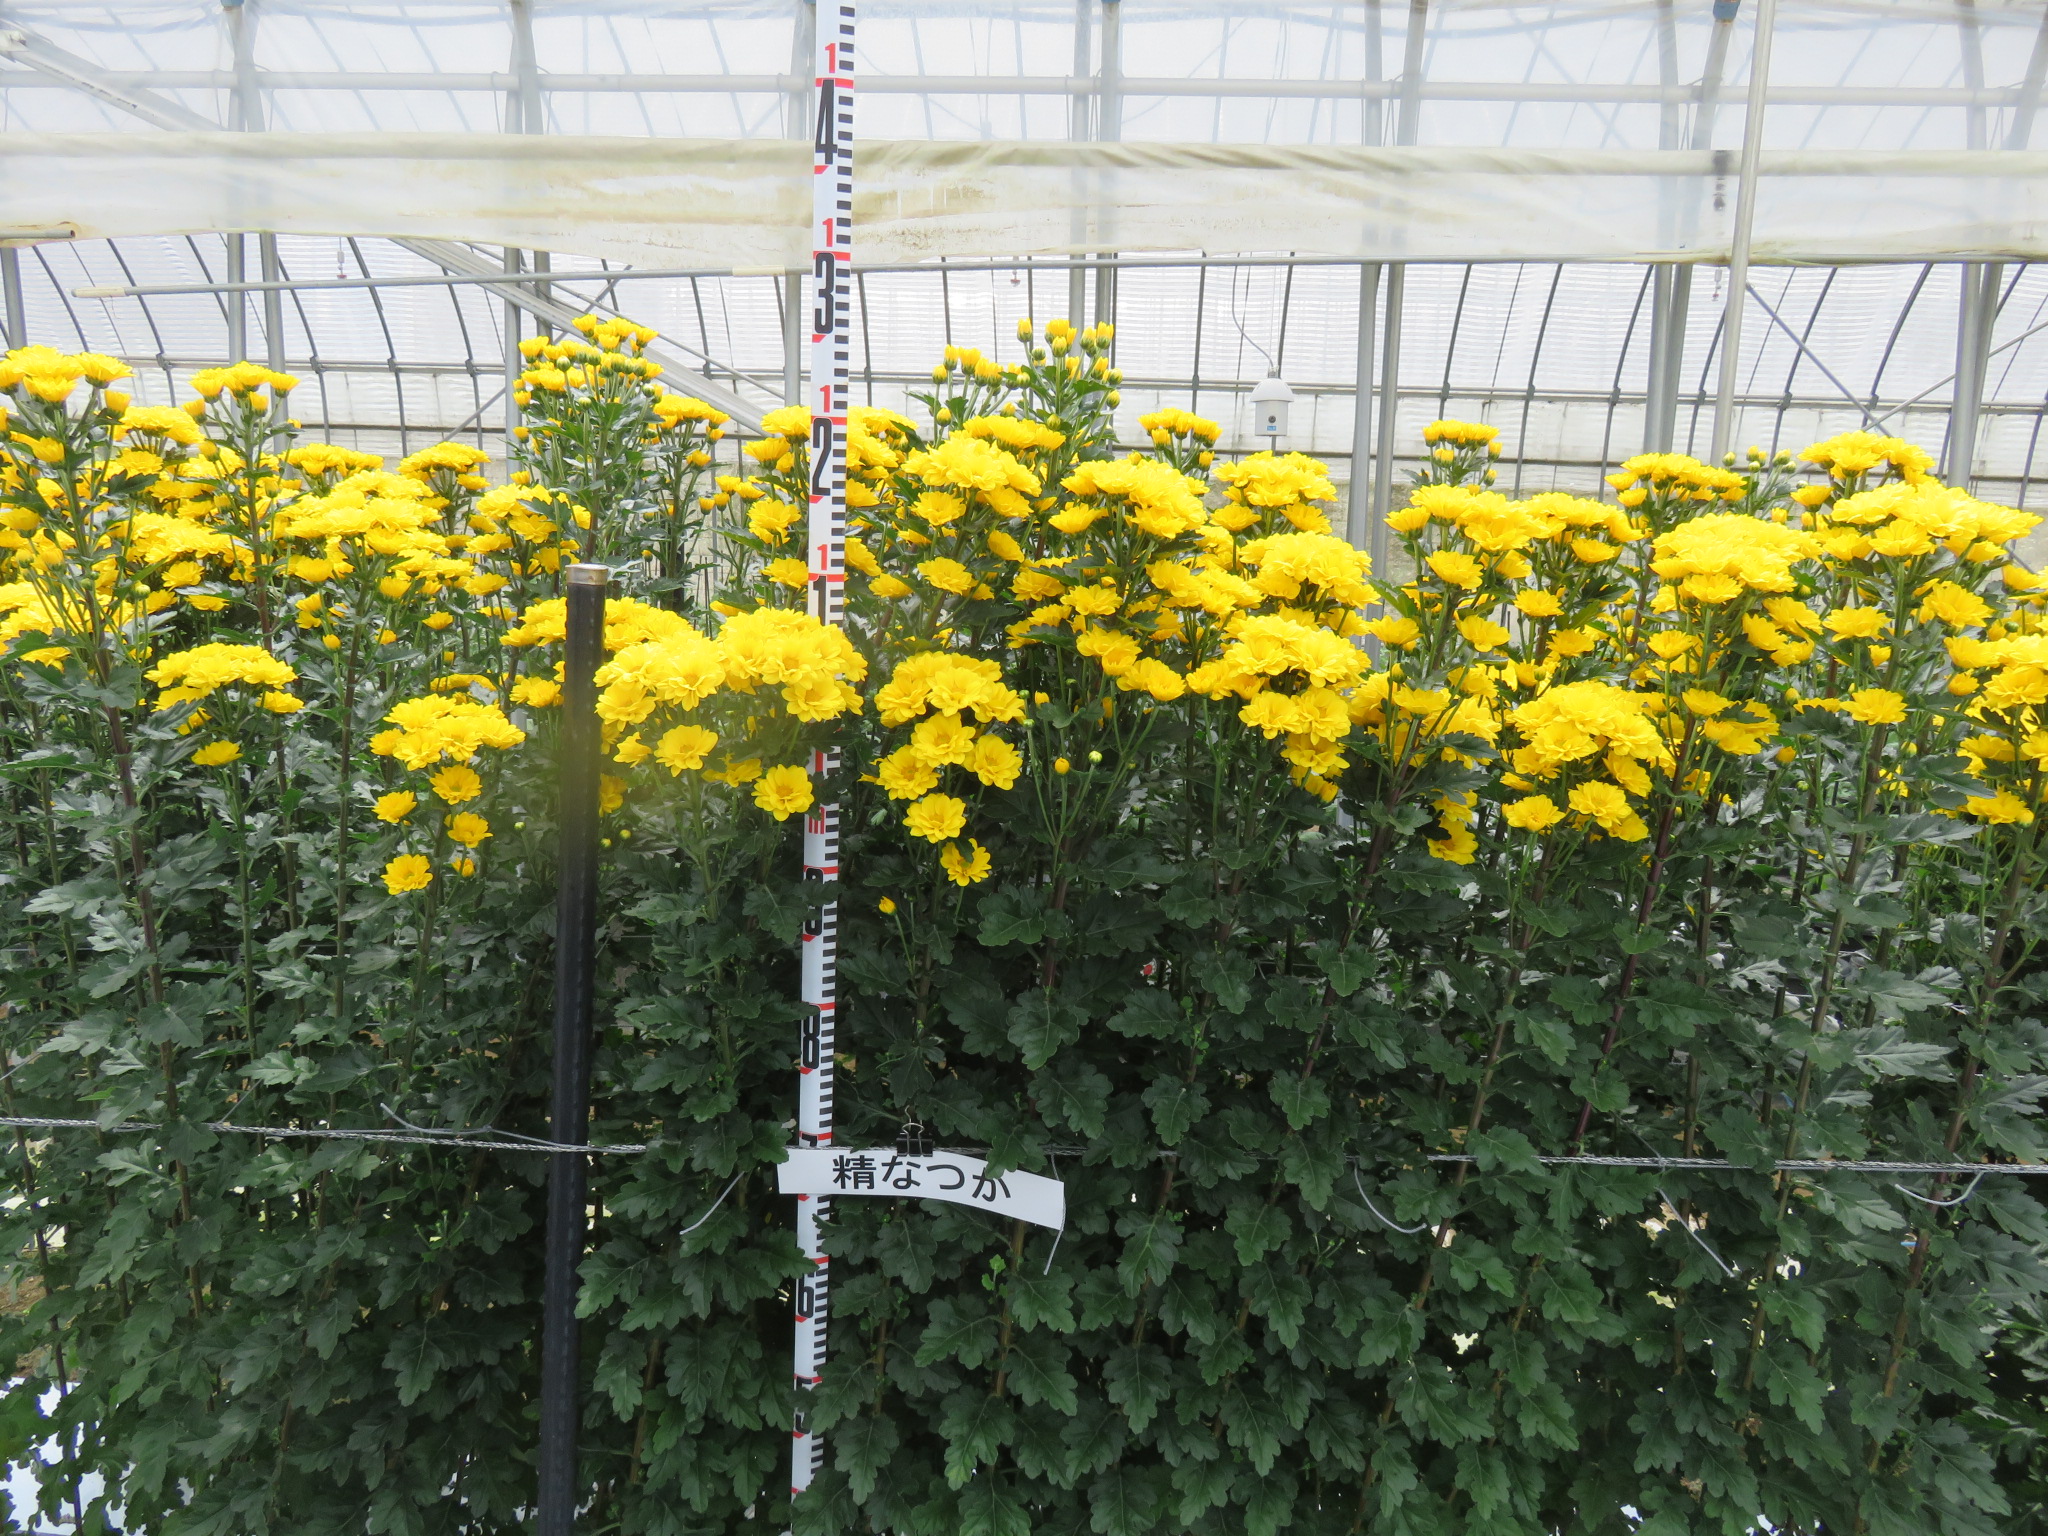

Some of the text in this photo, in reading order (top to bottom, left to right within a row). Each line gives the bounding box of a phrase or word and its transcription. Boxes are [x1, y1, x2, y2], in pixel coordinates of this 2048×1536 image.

[824, 42, 836, 74] 1
[814, 79, 838, 165] 4
[822, 217, 834, 248] 1
[814, 252, 835, 334] 3
[819, 384, 831, 413] 1
[812, 417, 832, 496] 2
[816, 543, 828, 571] 1
[802, 1004, 821, 1070] 8
[832, 1154, 1011, 1202] 精なつか
